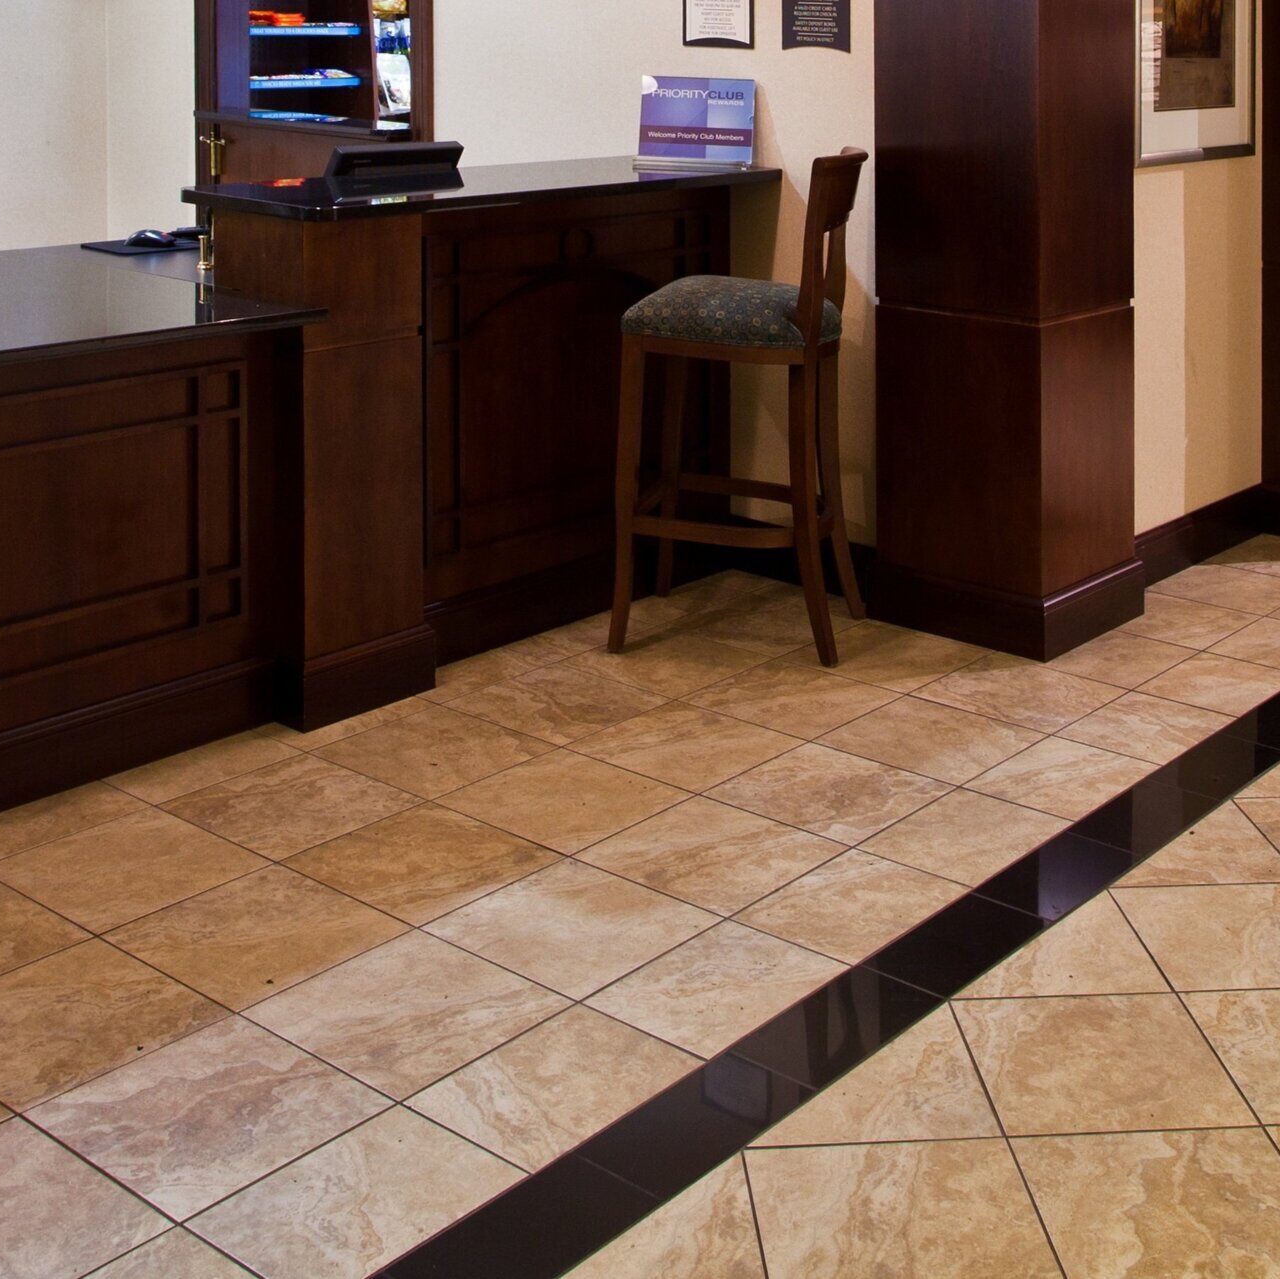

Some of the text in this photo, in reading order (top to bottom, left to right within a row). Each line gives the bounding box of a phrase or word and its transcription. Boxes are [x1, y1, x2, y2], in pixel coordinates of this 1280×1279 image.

[648, 131, 677, 139] Welcome
[677, 132, 698, 141] Priority
[715, 133, 745, 141] Members
